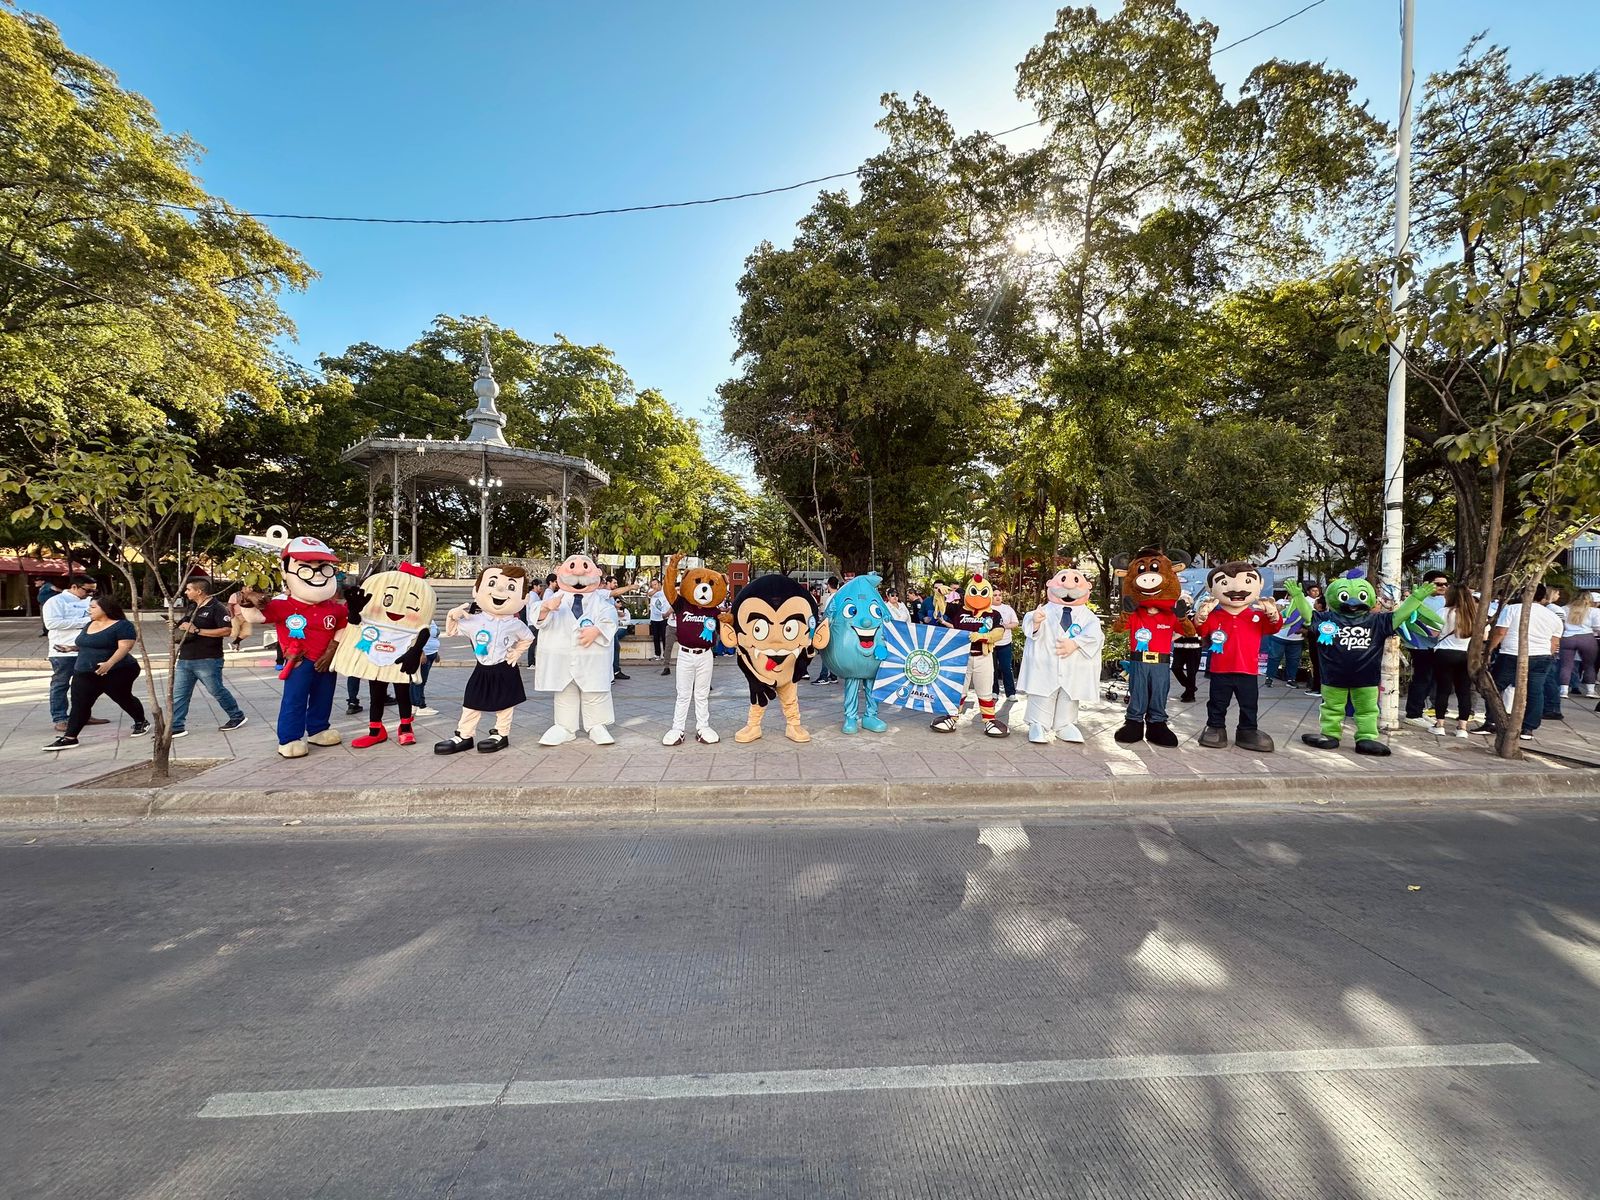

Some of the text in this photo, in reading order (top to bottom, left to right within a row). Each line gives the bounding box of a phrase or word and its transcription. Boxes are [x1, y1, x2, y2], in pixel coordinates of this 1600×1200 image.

[325, 616, 335, 629] K
[1340, 637, 1371, 651] apac
[910, 690, 935, 700] JAPAC
